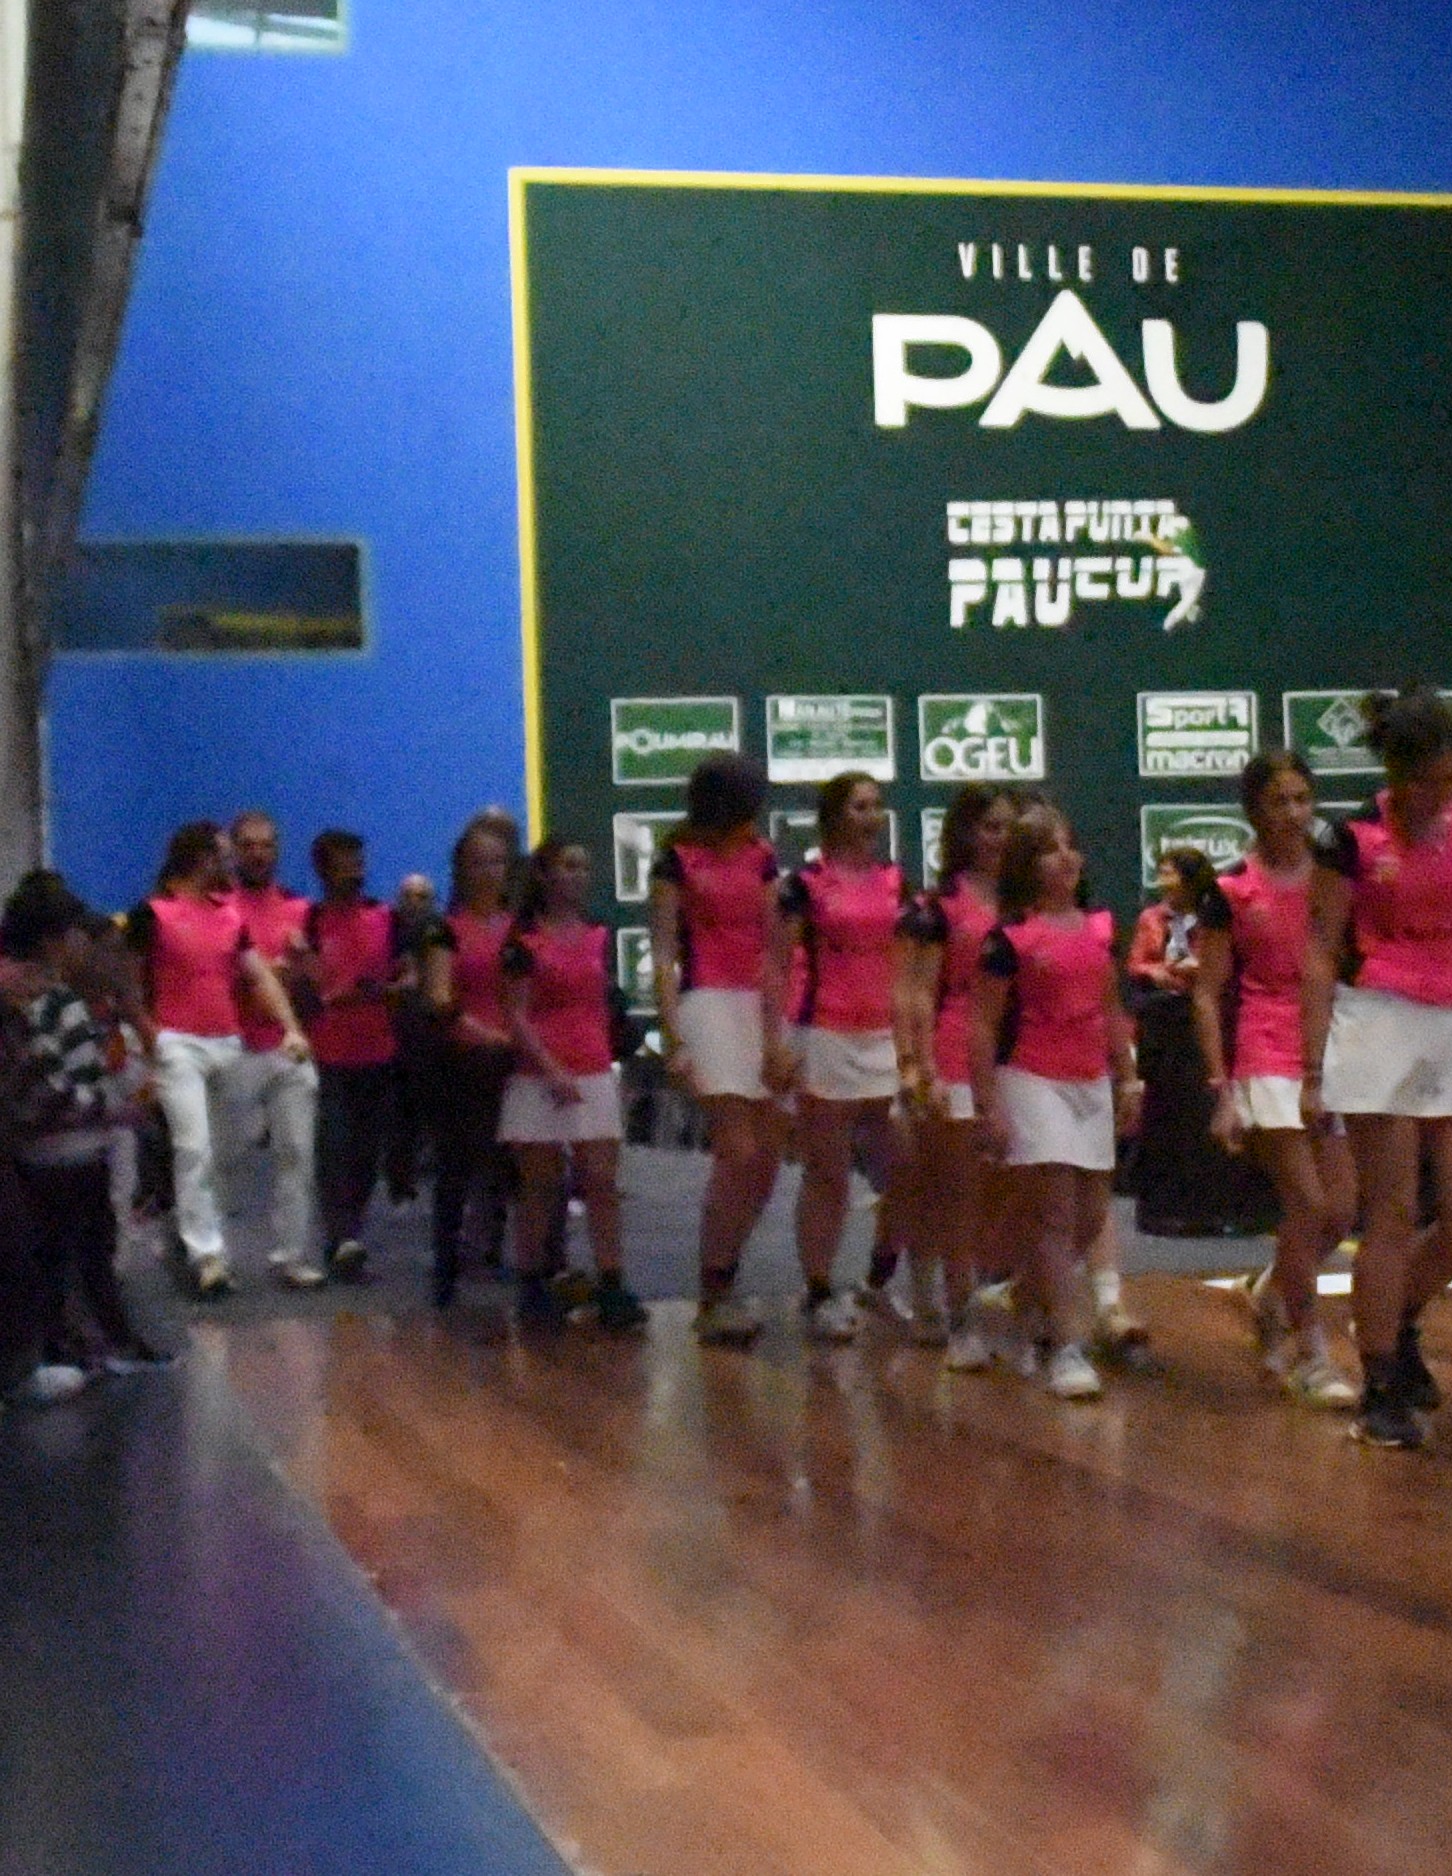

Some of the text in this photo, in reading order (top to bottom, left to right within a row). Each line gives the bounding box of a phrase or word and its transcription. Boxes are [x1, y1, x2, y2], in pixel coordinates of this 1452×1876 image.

[957, 241, 1181, 284] VILLE DE
[871, 289, 1270, 434] PAU
[947, 500, 1060, 544] CESTA
[948, 557, 1072, 630] PAU
[924, 735, 1041, 776] OGEU
